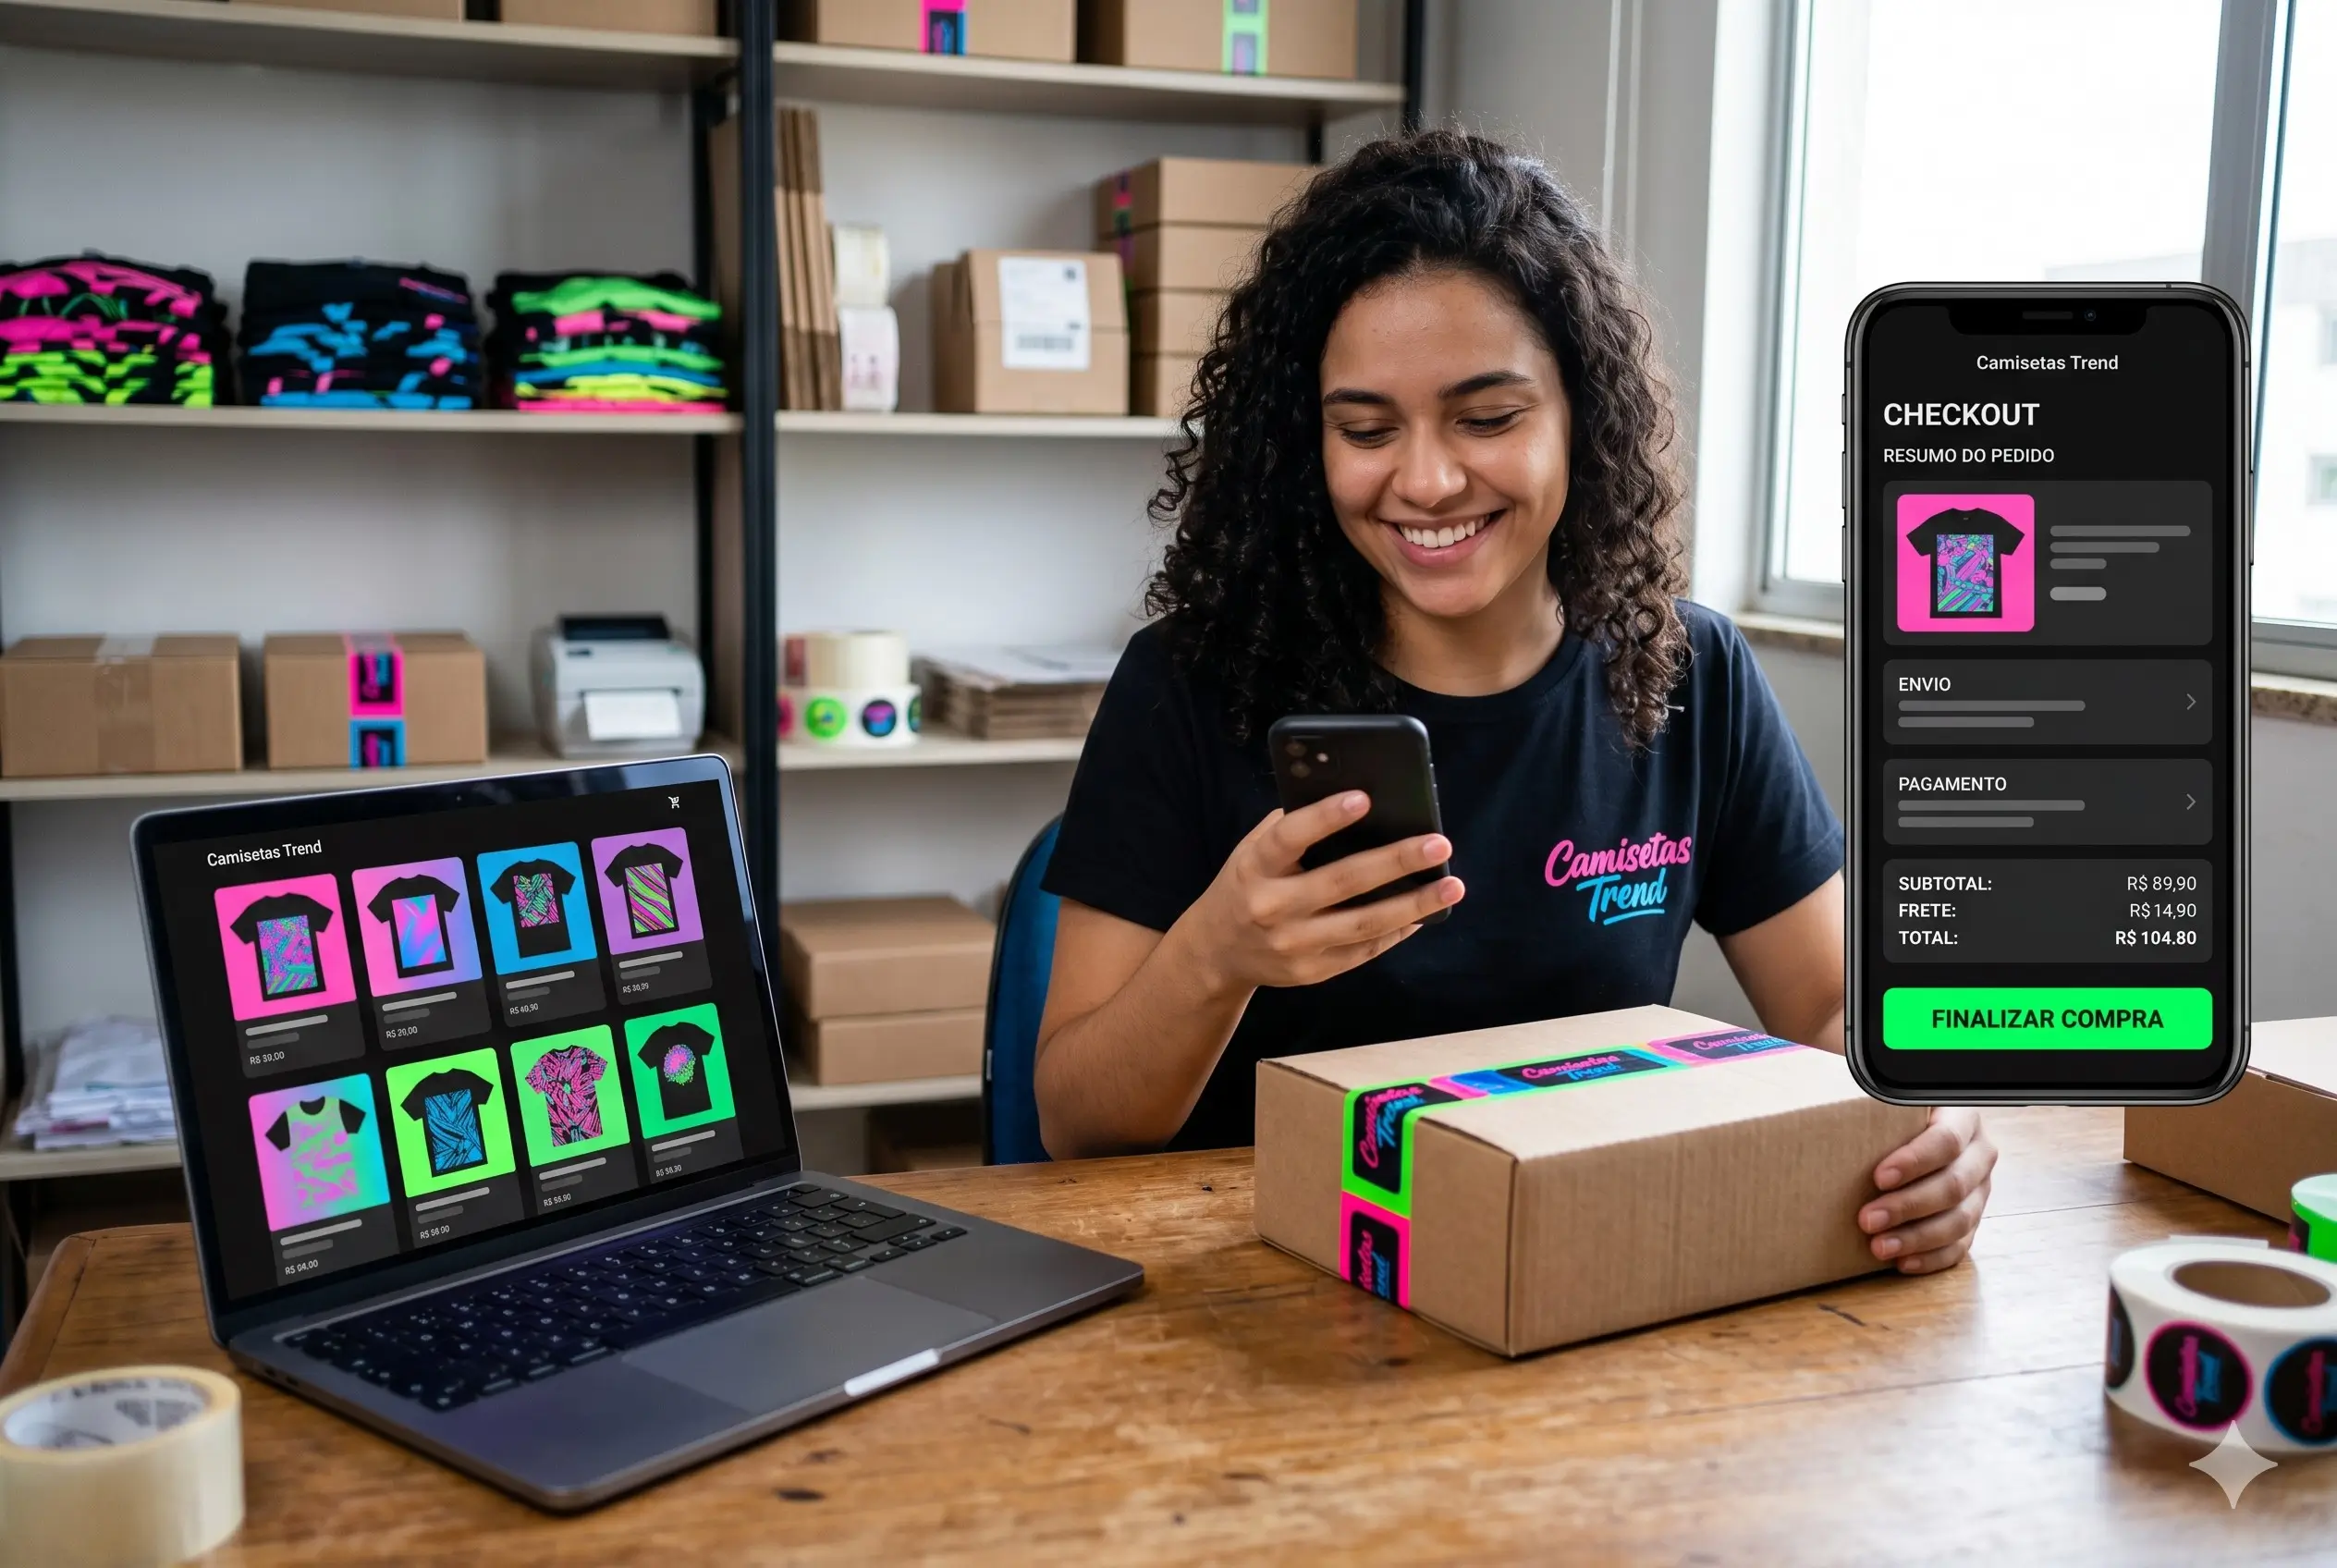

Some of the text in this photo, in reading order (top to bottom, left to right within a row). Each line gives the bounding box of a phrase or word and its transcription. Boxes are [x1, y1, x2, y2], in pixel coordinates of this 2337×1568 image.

[1976, 354, 2119, 371] Camisetas Trend
[1883, 402, 2040, 426] CHECKOUT
[1883, 447, 2055, 463] RESUMO DO PEDIDO
[1899, 677, 1952, 692] ENVIO
[1899, 776, 2007, 791] PAGAMENTO
[207, 839, 323, 866] Camisetas Trend
[1545, 832, 1692, 887] Camisetas
[1898, 874, 2197, 893] SUBTOTAL: R$ 89,90
[1576, 867, 1668, 923] Trend
[1899, 901, 2197, 920] FRETE: R$ 14,90
[1898, 928, 2197, 948] TOTAL: R$ 104.80
[1932, 1009, 2164, 1029] FINALIZAR COMPRA
